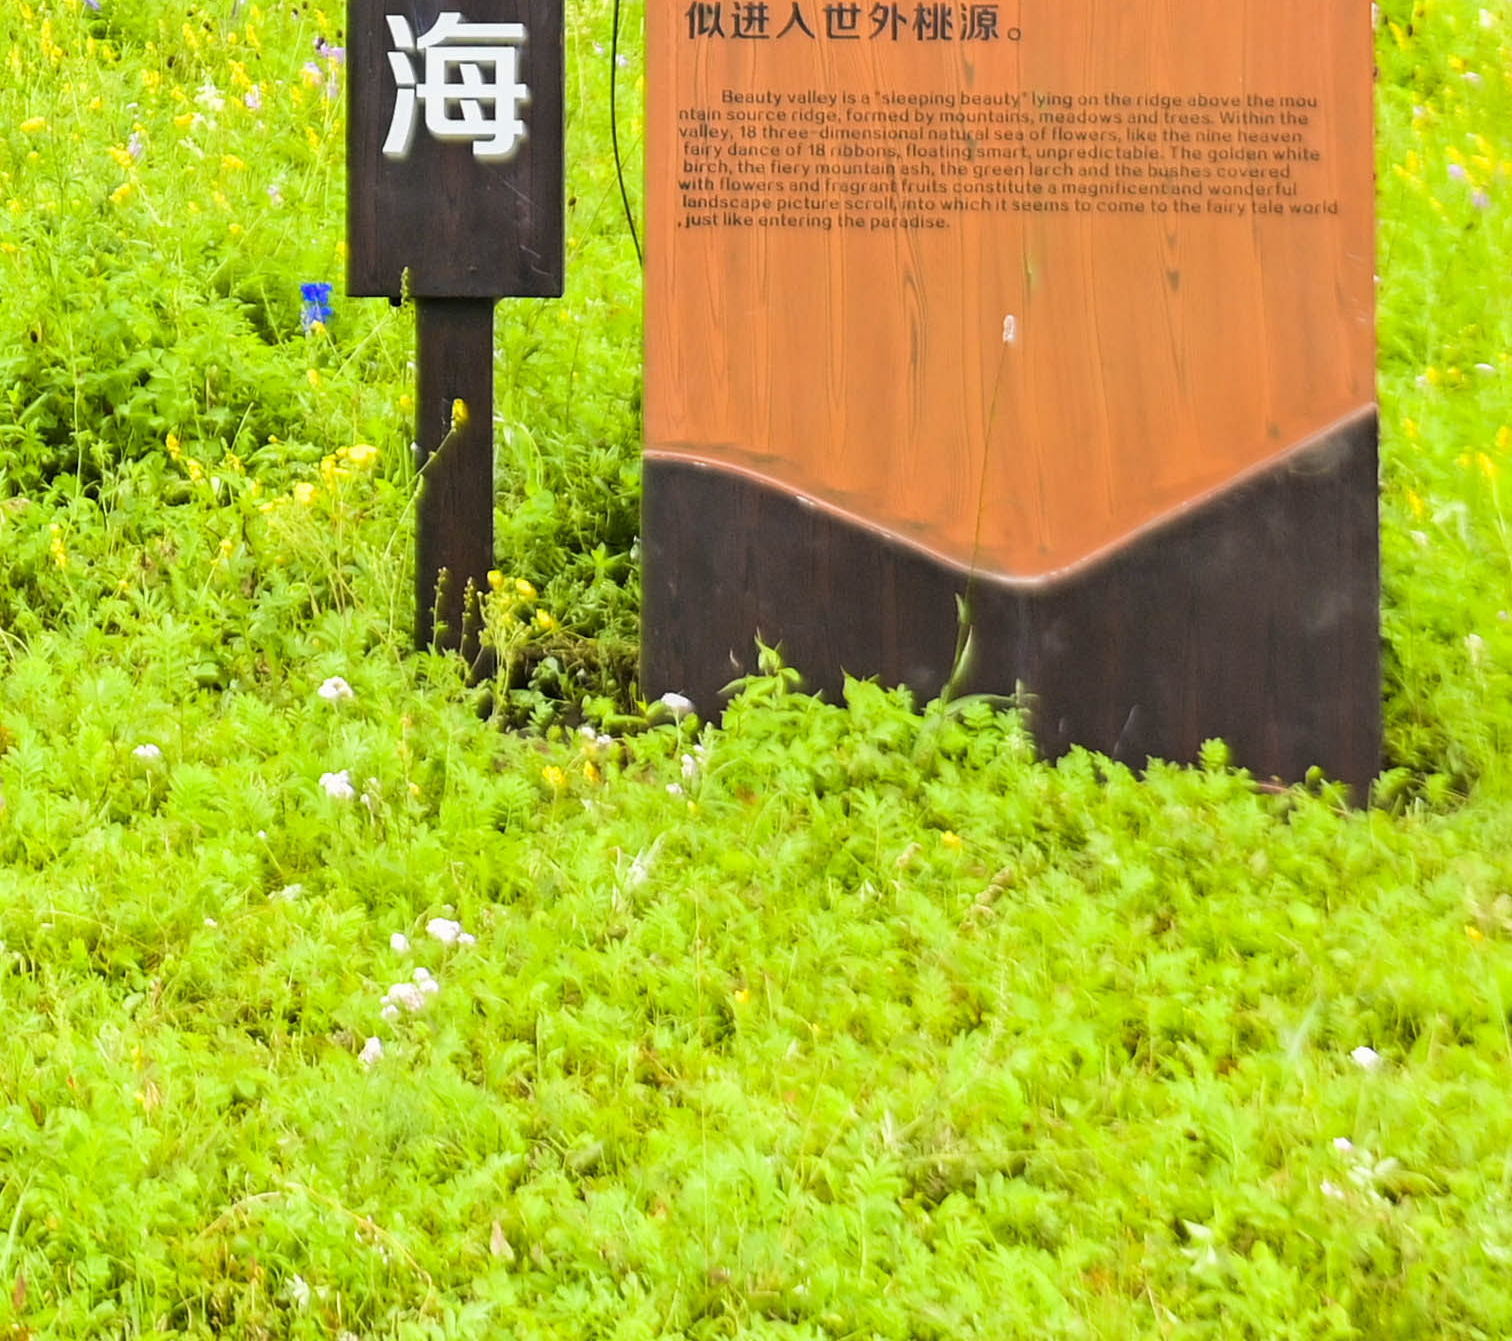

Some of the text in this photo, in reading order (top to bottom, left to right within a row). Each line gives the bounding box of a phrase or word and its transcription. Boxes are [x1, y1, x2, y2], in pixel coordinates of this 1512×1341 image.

[722, 90, 781, 106] Beauty
[788, 90, 837, 106] valley
[1032, 92, 1072, 108] lying
[1104, 92, 1131, 106] the
[1137, 93, 1182, 109] ridge
[1188, 93, 1240, 106] above
[1247, 93, 1274, 107] the
[1280, 97, 1317, 107] mou
[680, 107, 721, 121] ntain
[726, 111, 786, 122] source
[847, 108, 909, 122] formed
[1040, 109, 1120, 124] meadows
[1128, 110, 1158, 124] and
[1220, 110, 1274, 125] Within
[1281, 111, 1308, 125] the
[763, 125, 923, 139] three-dimensional
[929, 125, 988, 140] natural
[994, 129, 1023, 140] sea
[1127, 127, 1157, 141] like
[1163, 127, 1190, 141] the
[1196, 127, 1232, 142] nine
[1238, 128, 1302, 142] heaven
[684, 142, 721, 159] fairy
[728, 142, 779, 157] dance
[907, 143, 971, 161] floating
[1170, 145, 1201, 160] The
[1208, 145, 1267, 163] golden
[1274, 146, 1320, 160] white
[738, 159, 765, 174] the
[771, 159, 809, 177] fiery
[816, 160, 894, 175] mountain
[941, 161, 967, 175] the
[973, 165, 1024, 178] green
[1030, 162, 1072, 176] larch
[1079, 162, 1108, 177] and
[1115, 162, 1142, 177] the
[1148, 163, 1211, 177] bushes
[1217, 163, 1290, 178] covered
[679, 177, 714, 191] with
[720, 177, 783, 192] flowers
[790, 177, 820, 192] and
[826, 178, 896, 195] fragrant
[902, 178, 946, 193] fruits
[953, 179, 1042, 193] constitute
[1062, 180, 1166, 197] magnificent
[1173, 180, 1202, 195] and
[1208, 181, 1296, 195] wonderful
[683, 194, 771, 212] landscape
[777, 195, 839, 212] picture
[903, 196, 935, 210] into
[941, 196, 990, 211] which
[1013, 200, 1069, 211] seems
[1097, 201, 1144, 212] come
[1173, 198, 1200, 212] the
[1207, 198, 1245, 215] fairy
[1252, 199, 1283, 213] tale
[1290, 199, 1338, 213] world
[686, 212, 717, 229] just
[723, 212, 753, 226] like
[759, 212, 831, 229] entering
[838, 213, 865, 227] the
